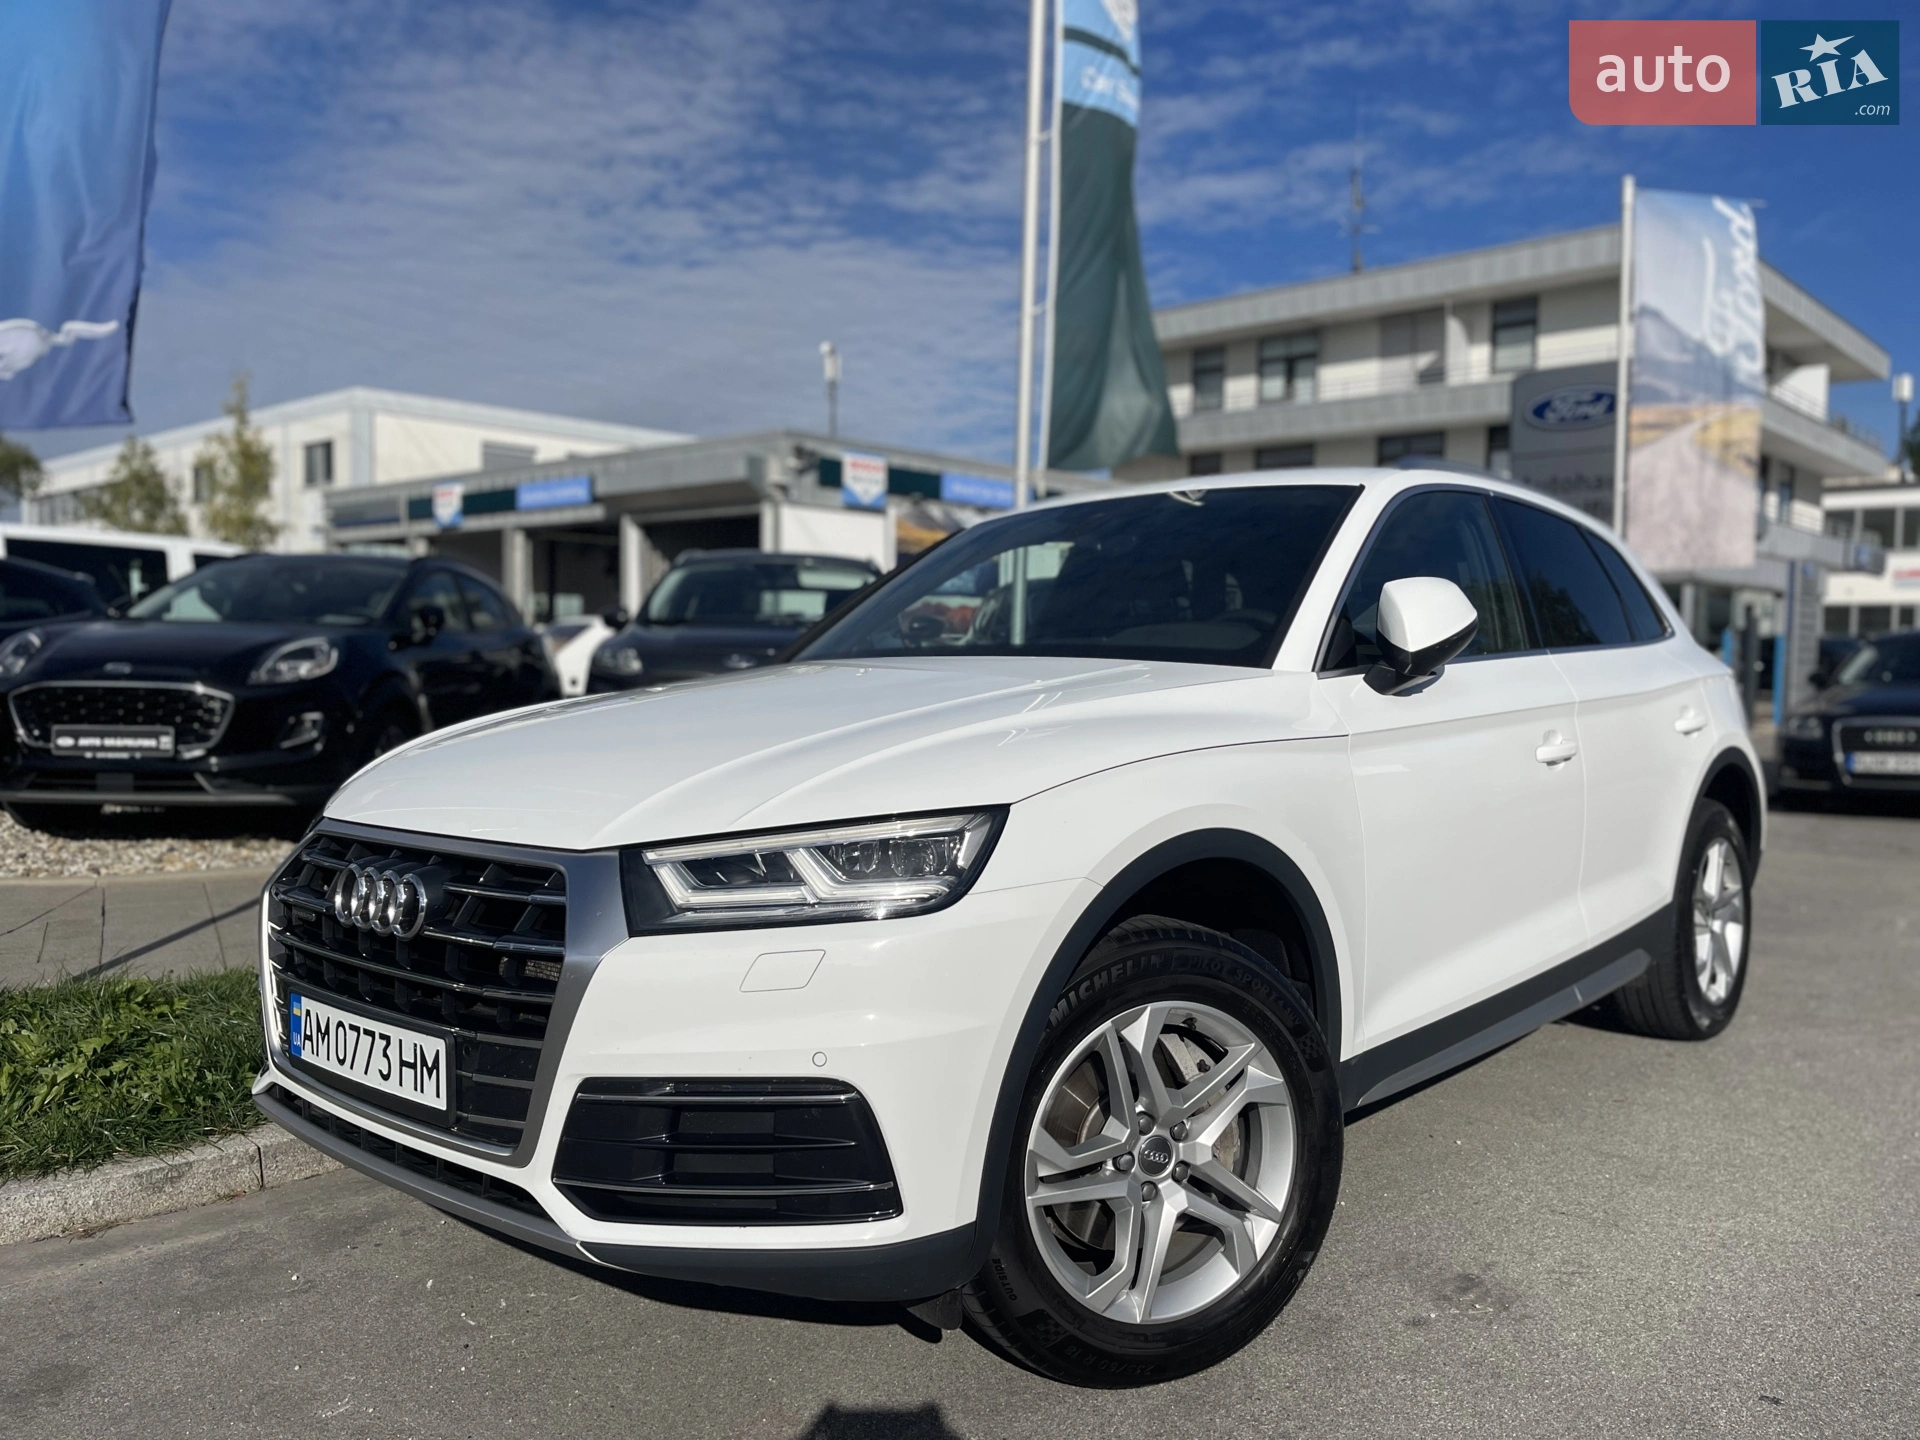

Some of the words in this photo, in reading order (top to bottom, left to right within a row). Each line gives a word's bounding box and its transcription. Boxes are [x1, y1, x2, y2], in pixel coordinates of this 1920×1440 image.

[1543, 391, 1611, 424] Ford
[1049, 953, 1165, 1028] MICHELIN
[1234, 969, 1276, 1000] SPORT
[293, 1032, 301, 1047] UA
[991, 1258, 1018, 1301] OUTSIDE
